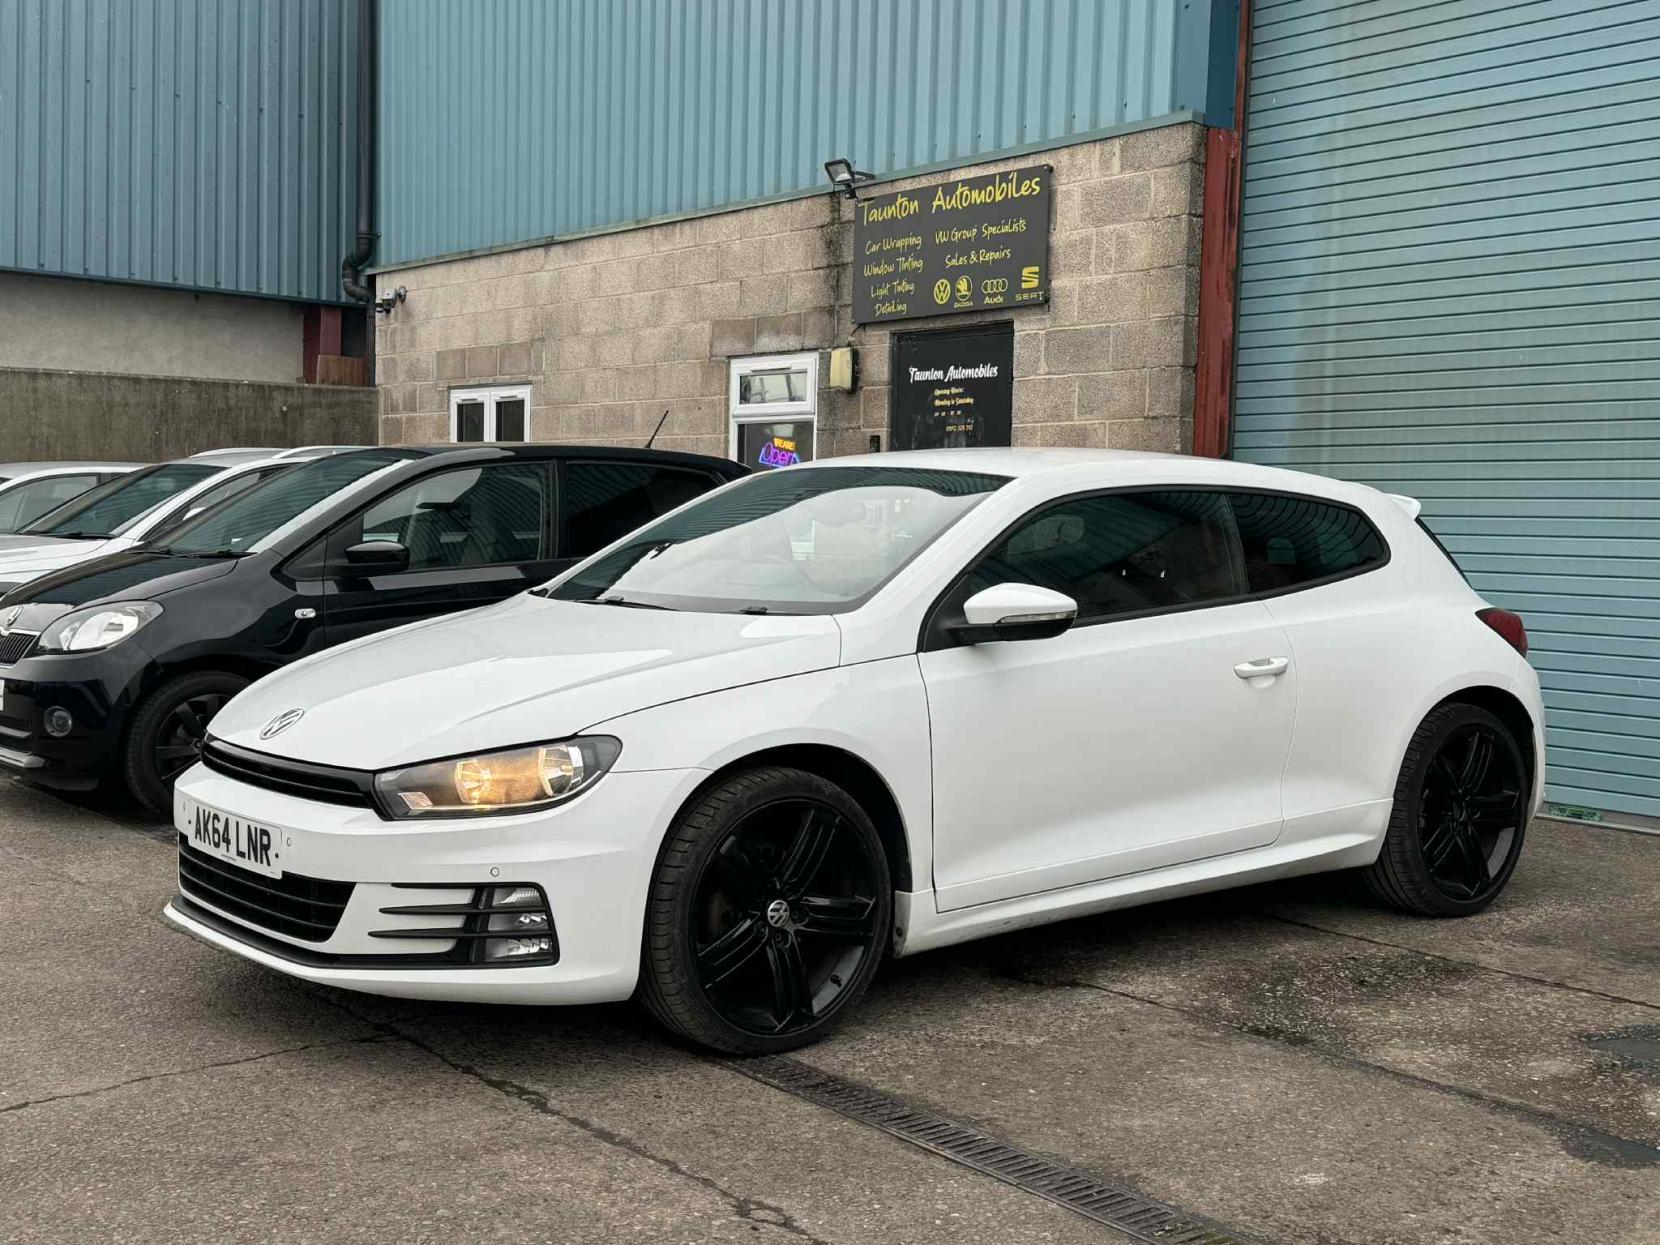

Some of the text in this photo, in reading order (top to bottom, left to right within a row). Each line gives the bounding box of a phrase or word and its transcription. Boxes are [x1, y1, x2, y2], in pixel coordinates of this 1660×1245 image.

[858, 171, 1041, 226] Taunton Automobiles
[935, 217, 1027, 245] VW Group Specialists
[865, 232, 922, 255] Car Wrapping
[863, 252, 923, 277] Window Tinting
[945, 245, 1011, 269] Sales & Repairs
[871, 278, 915, 300] Light Tinting
[874, 299, 907, 317] Detailing
[908, 363, 999, 384] Taunton Automobiles
[195, 806, 271, 866] AK64 LNR
